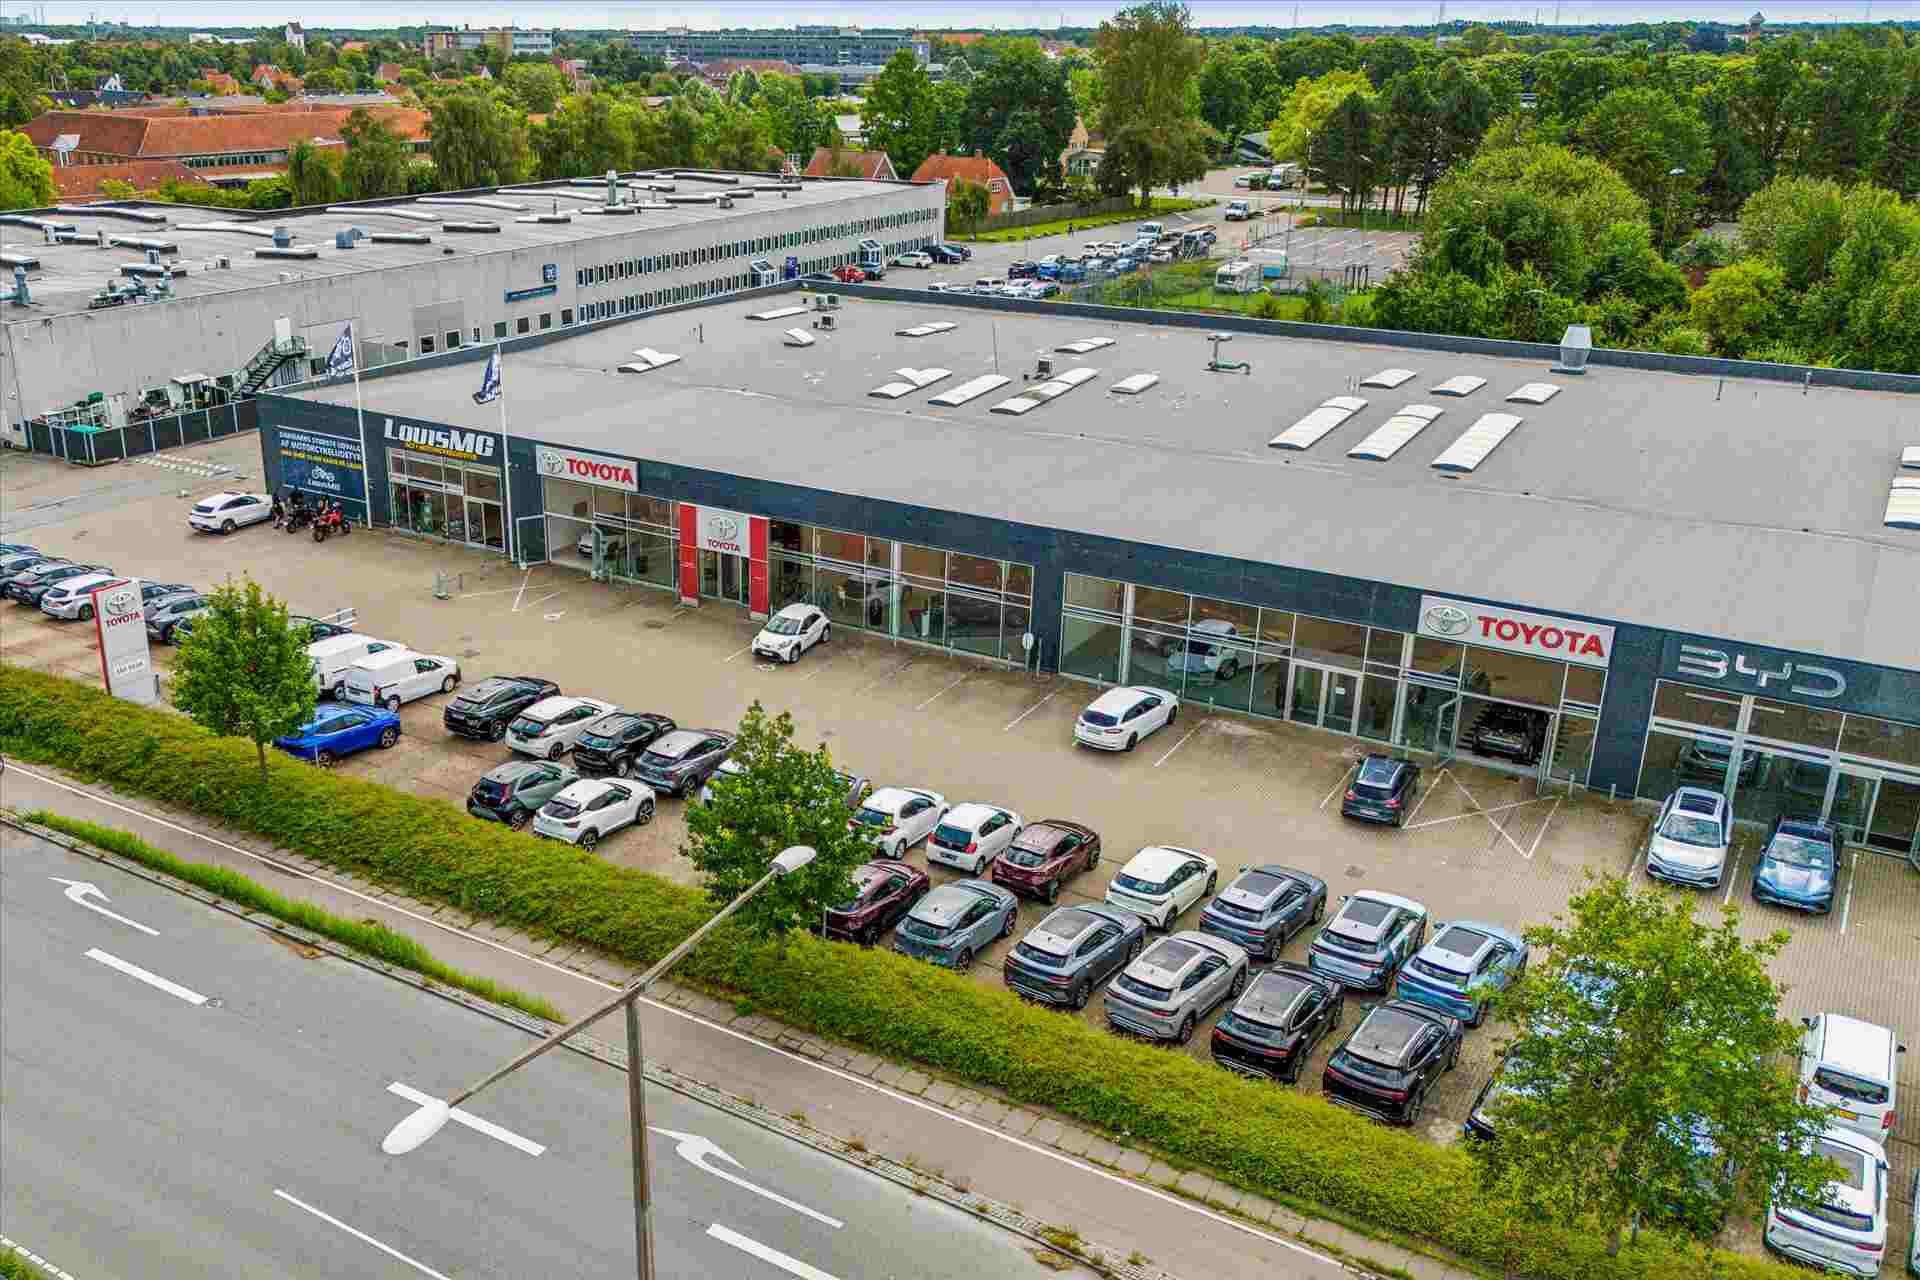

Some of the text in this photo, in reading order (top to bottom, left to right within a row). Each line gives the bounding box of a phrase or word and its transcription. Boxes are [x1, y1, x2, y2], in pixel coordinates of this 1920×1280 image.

[566, 458, 636, 485] TOYOTA
[707, 538, 741, 551] TOYOTA
[106, 611, 141, 628] TOYOTA
[1477, 616, 1605, 657] TOYOTA
[1678, 644, 1847, 698] BYD
